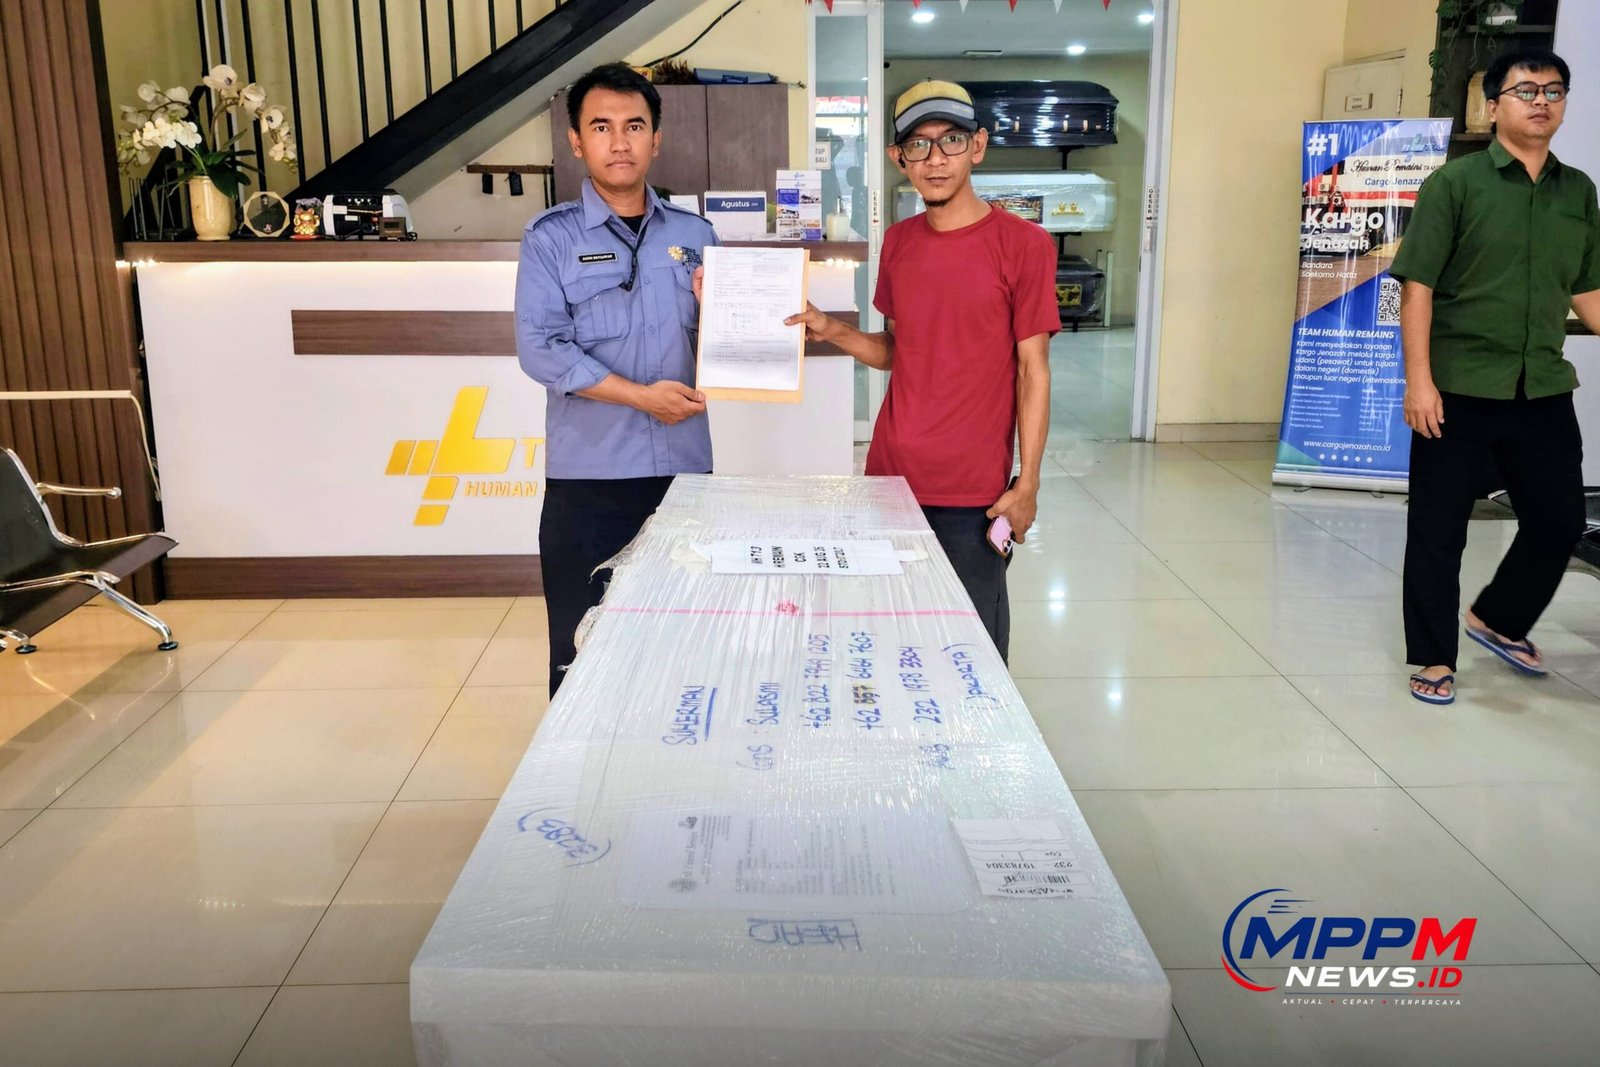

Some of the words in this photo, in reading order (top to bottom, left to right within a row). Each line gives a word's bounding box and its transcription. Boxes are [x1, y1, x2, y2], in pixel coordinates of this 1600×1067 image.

[1307, 131, 1339, 156] #1
[720, 200, 750, 210] Agustus
[1305, 207, 1384, 236] Kargo
[1303, 236, 1369, 250] Jenazah
[1301, 261, 1333, 269] Bandara
[1301, 271, 1335, 279] Soekarno
[1336, 271, 1357, 279] Hatta
[1298, 327, 1321, 336] TEAM
[1322, 329, 1355, 338] HUMAN
[1355, 330, 1395, 339] REMAINS
[1315, 341, 1363, 350] menyediakan
[1363, 343, 1393, 351] layanan
[1317, 349, 1346, 357] Jenazah
[1347, 350, 1373, 358] melalui
[1374, 352, 1396, 360] kargo
[1317, 357, 1353, 366] (pesawat)
[1375, 361, 1398, 369] tujuan
[1317, 366, 1340, 375] negeri
[1341, 366, 1379, 376] (domestik)
[1293, 373, 1323, 382] maupun
[1338, 375, 1361, 384] negeri
[521, 437, 545, 469] T
[1303, 440, 1391, 452] www.cargojenazah.co.id
[464, 480, 538, 498] HUMAN
[807, 633, 830, 655] 1205
[898, 646, 924, 668] 3304
[898, 672, 931, 692] 1978
[802, 684, 831, 703] 822
[746, 682, 781, 726] SULASMI
[913, 698, 942, 724] 232
[661, 685, 706, 746] SUHERMAN
[850, 707, 885, 730] +62
